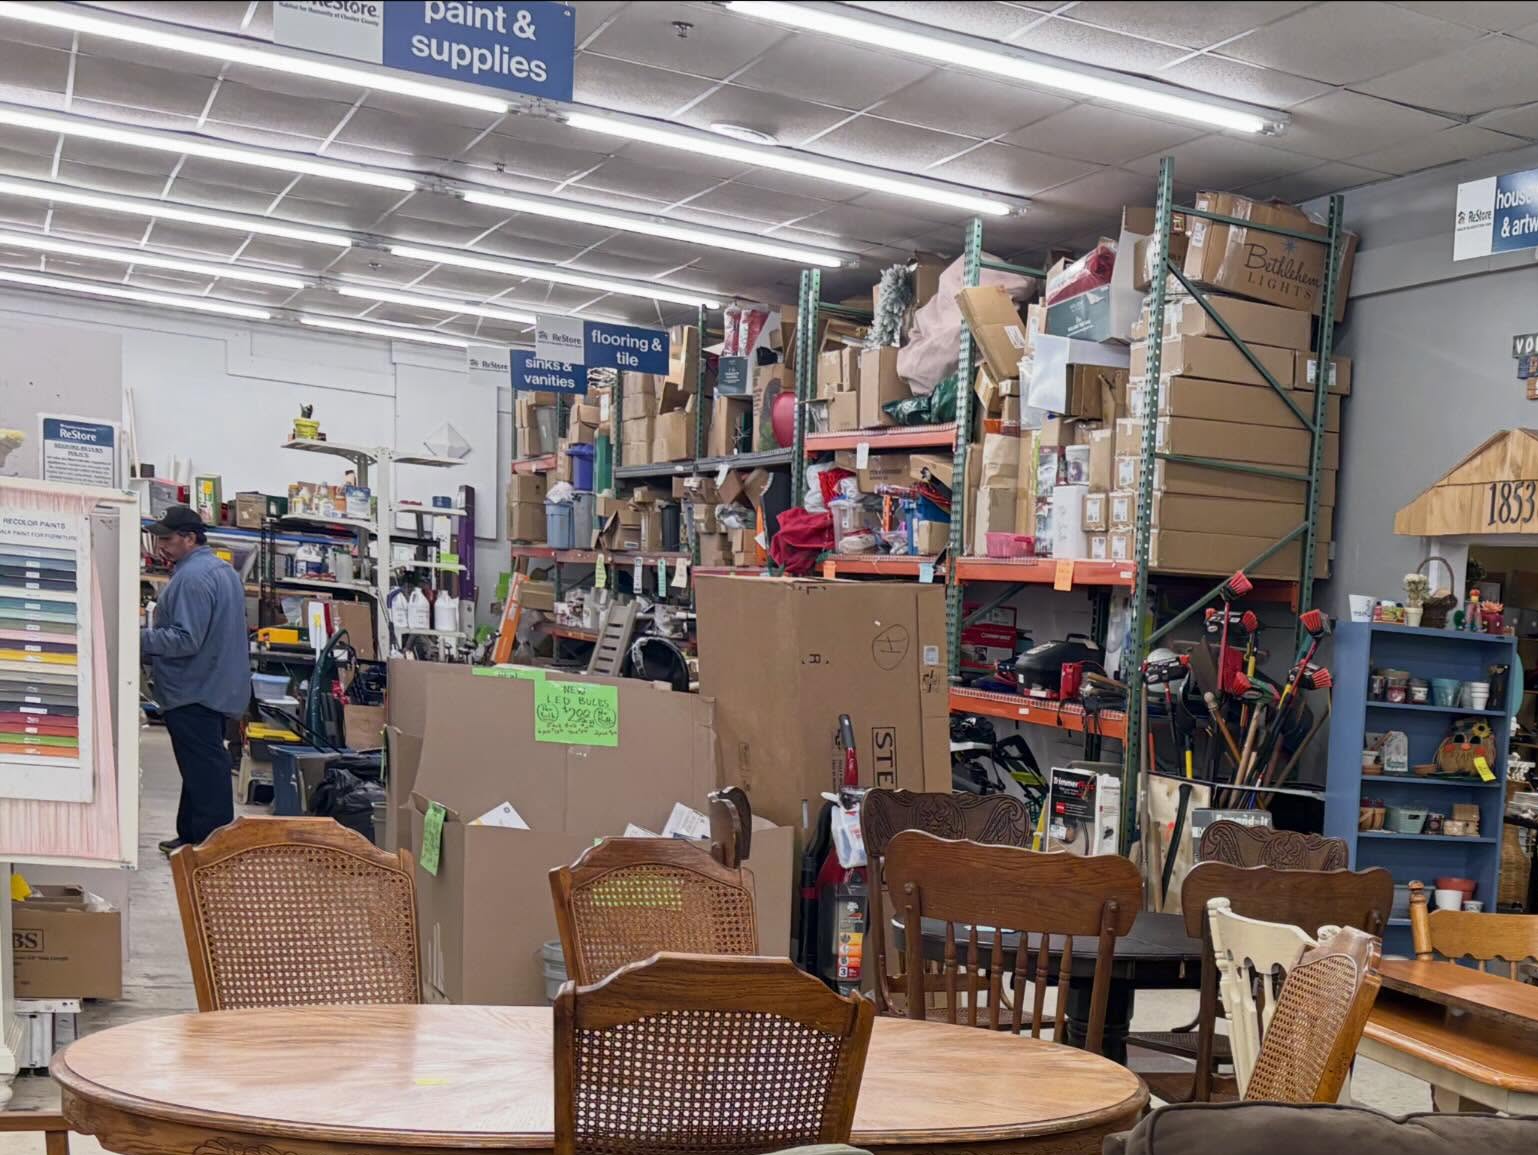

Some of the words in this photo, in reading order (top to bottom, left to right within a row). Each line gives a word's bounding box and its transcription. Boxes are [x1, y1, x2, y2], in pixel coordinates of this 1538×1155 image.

[424, 0, 506, 33] paint
[512, 9, 536, 40] &
[411, 34, 547, 82] supplies
[1468, 208, 1492, 223] ReStore
[1501, 216, 1511, 239] &
[1244, 243, 1322, 288] Bethlehem
[1247, 271, 1312, 299] LIGHTS
[552, 332, 582, 345] ReStore
[591, 329, 649, 352] flooring
[650, 337, 663, 352] &
[482, 360, 509, 371] ReStore
[525, 357, 561, 372] sinks
[562, 361, 574, 373] &
[616, 351, 640, 367] tile
[523, 373, 576, 389] vanities
[60, 428, 97, 442] ReStore
[1488, 480, 1536, 526] 1853
[3, 517, 39, 527] RECOLOR
[40, 520, 66, 530] PAINTS
